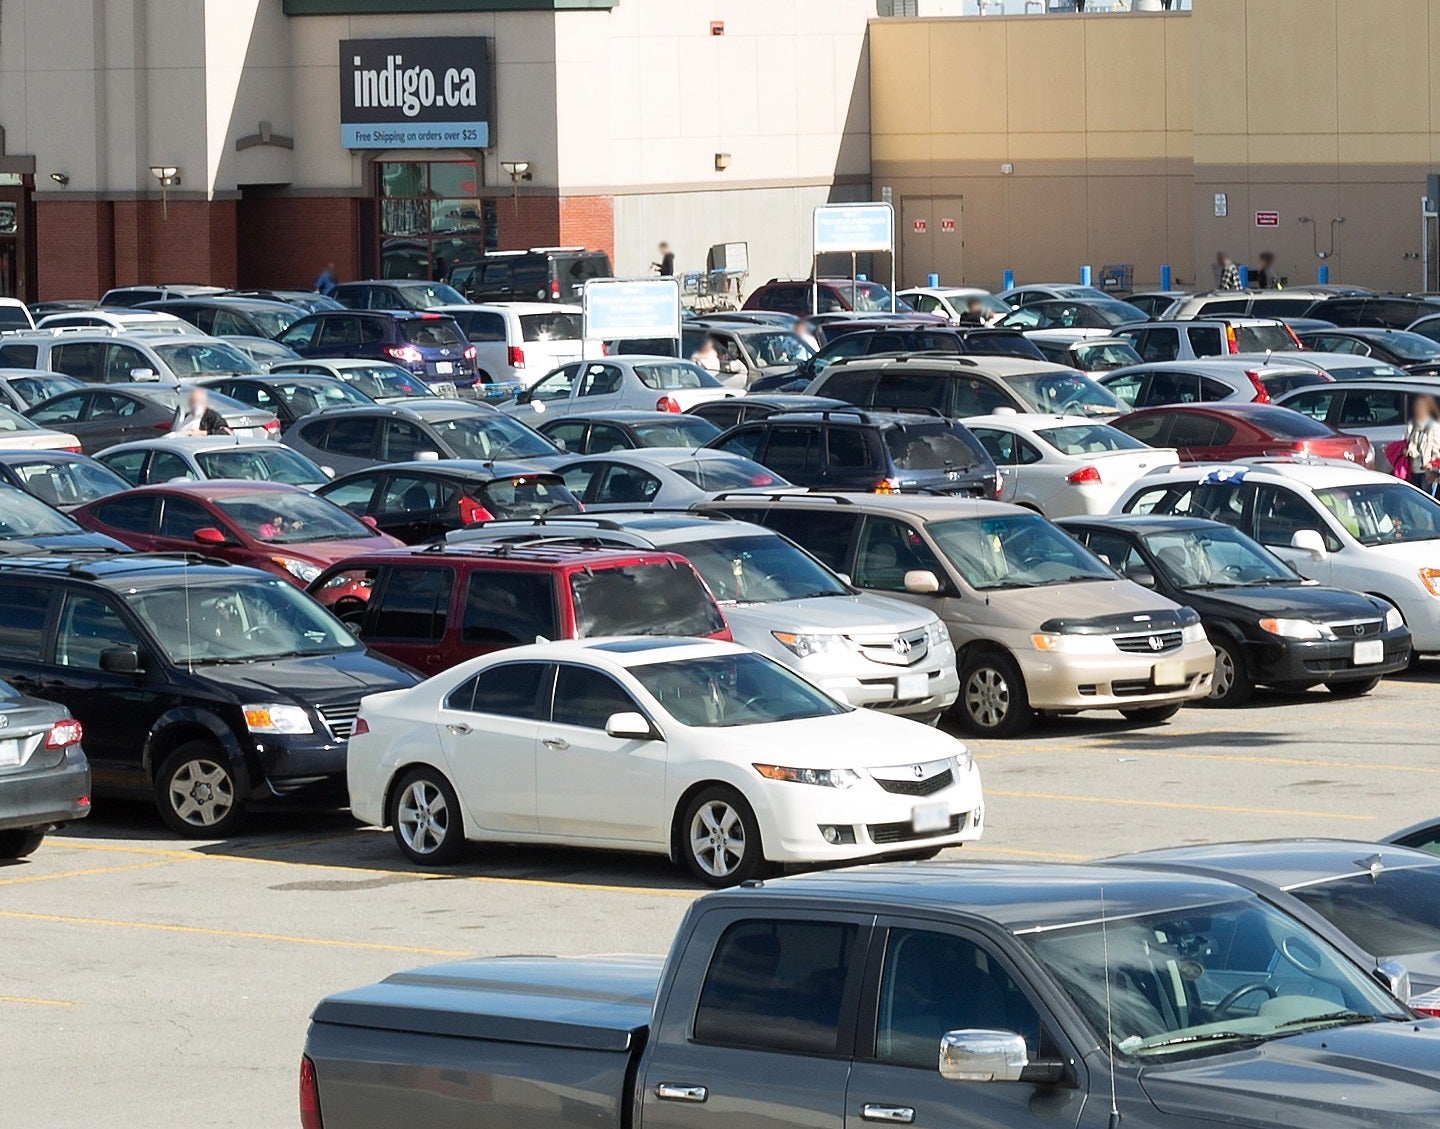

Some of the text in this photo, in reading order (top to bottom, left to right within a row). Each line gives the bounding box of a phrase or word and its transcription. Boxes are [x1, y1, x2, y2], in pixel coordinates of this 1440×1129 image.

[354, 55, 477, 117] indigo.ca
[355, 129, 477, 144] Free Shipping on orders over $25
